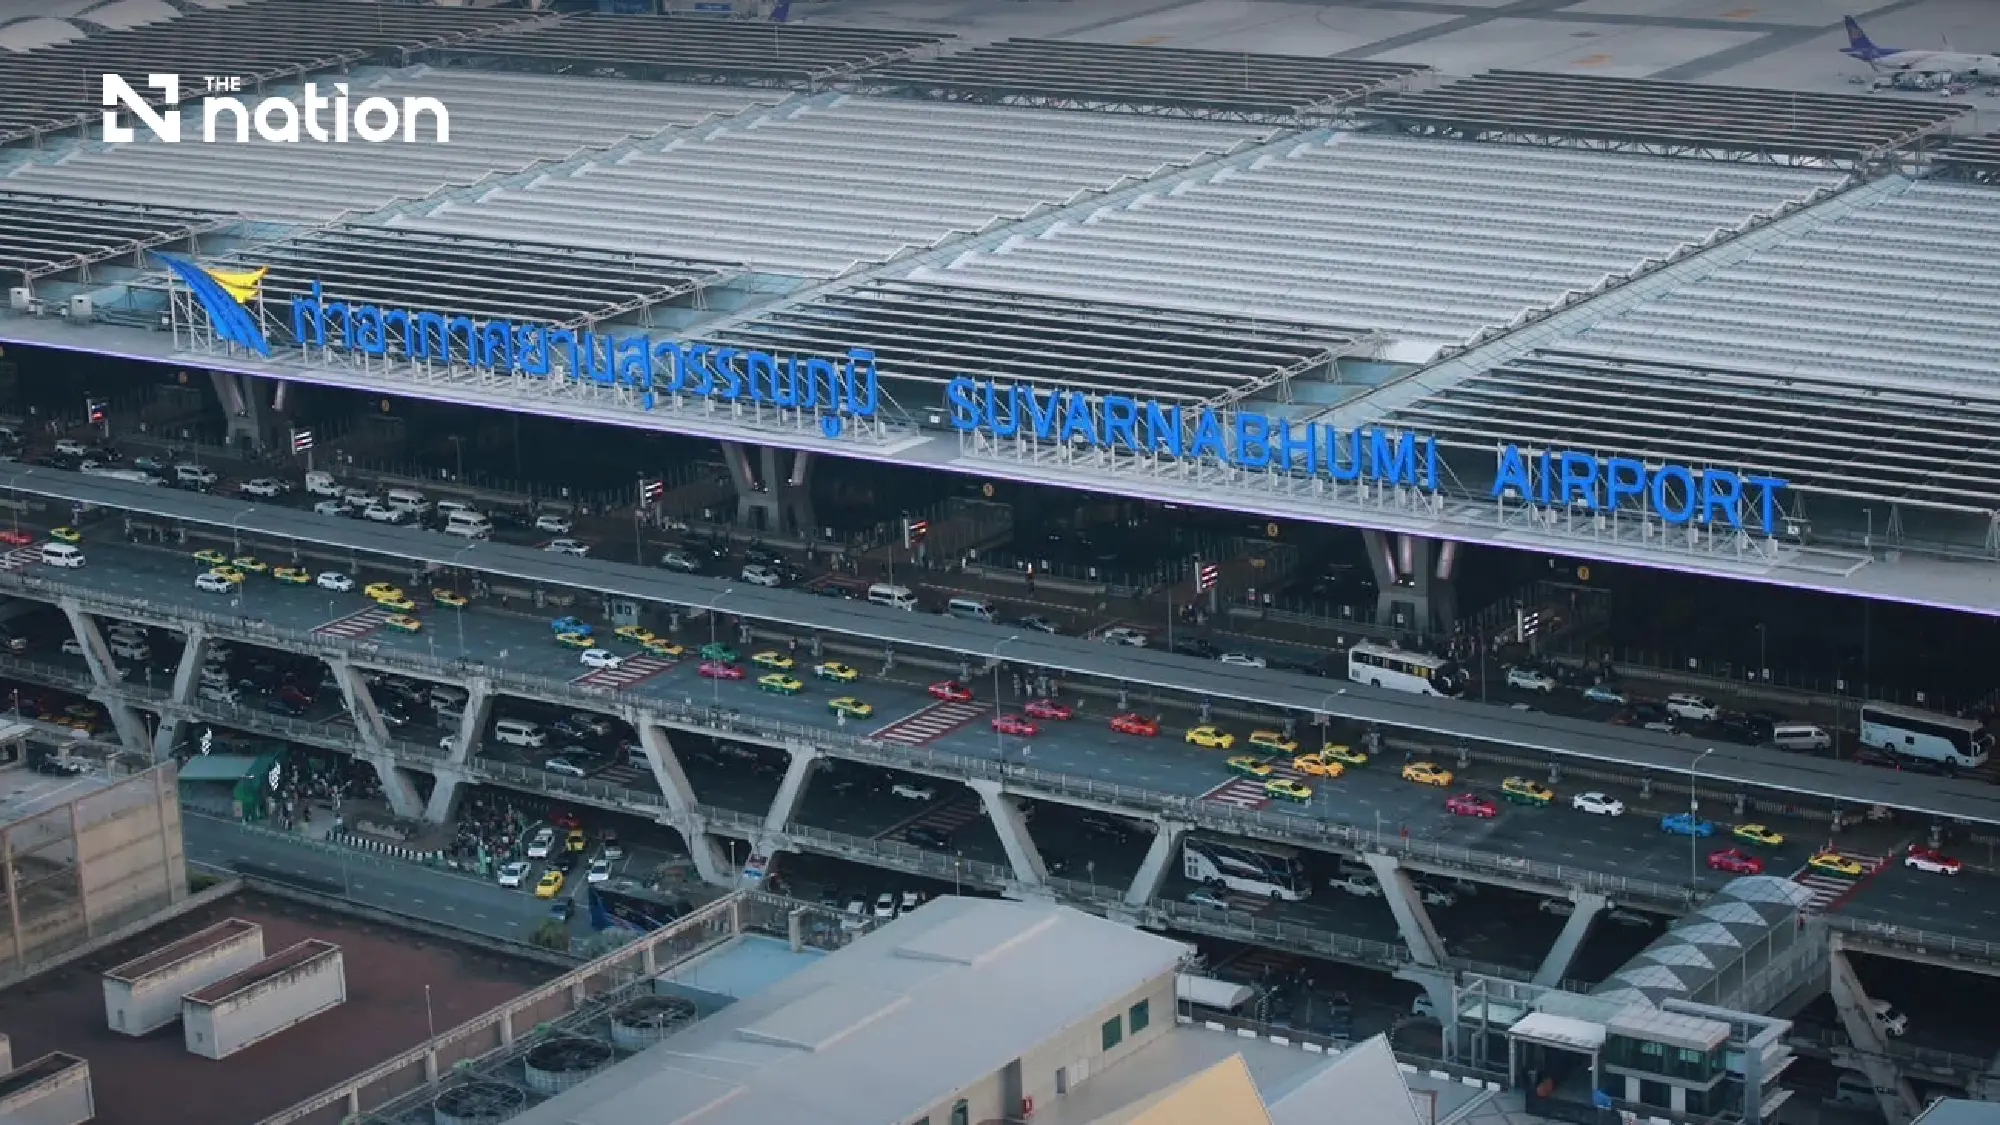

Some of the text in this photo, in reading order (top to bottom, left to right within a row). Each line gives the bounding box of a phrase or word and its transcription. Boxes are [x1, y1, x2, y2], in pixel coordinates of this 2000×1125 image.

[291, 279, 878, 439] ท่าอากาศยานสุวรรณภูมิ
[945, 376, 1790, 536] SUVARNABHUMI AIRPORT
